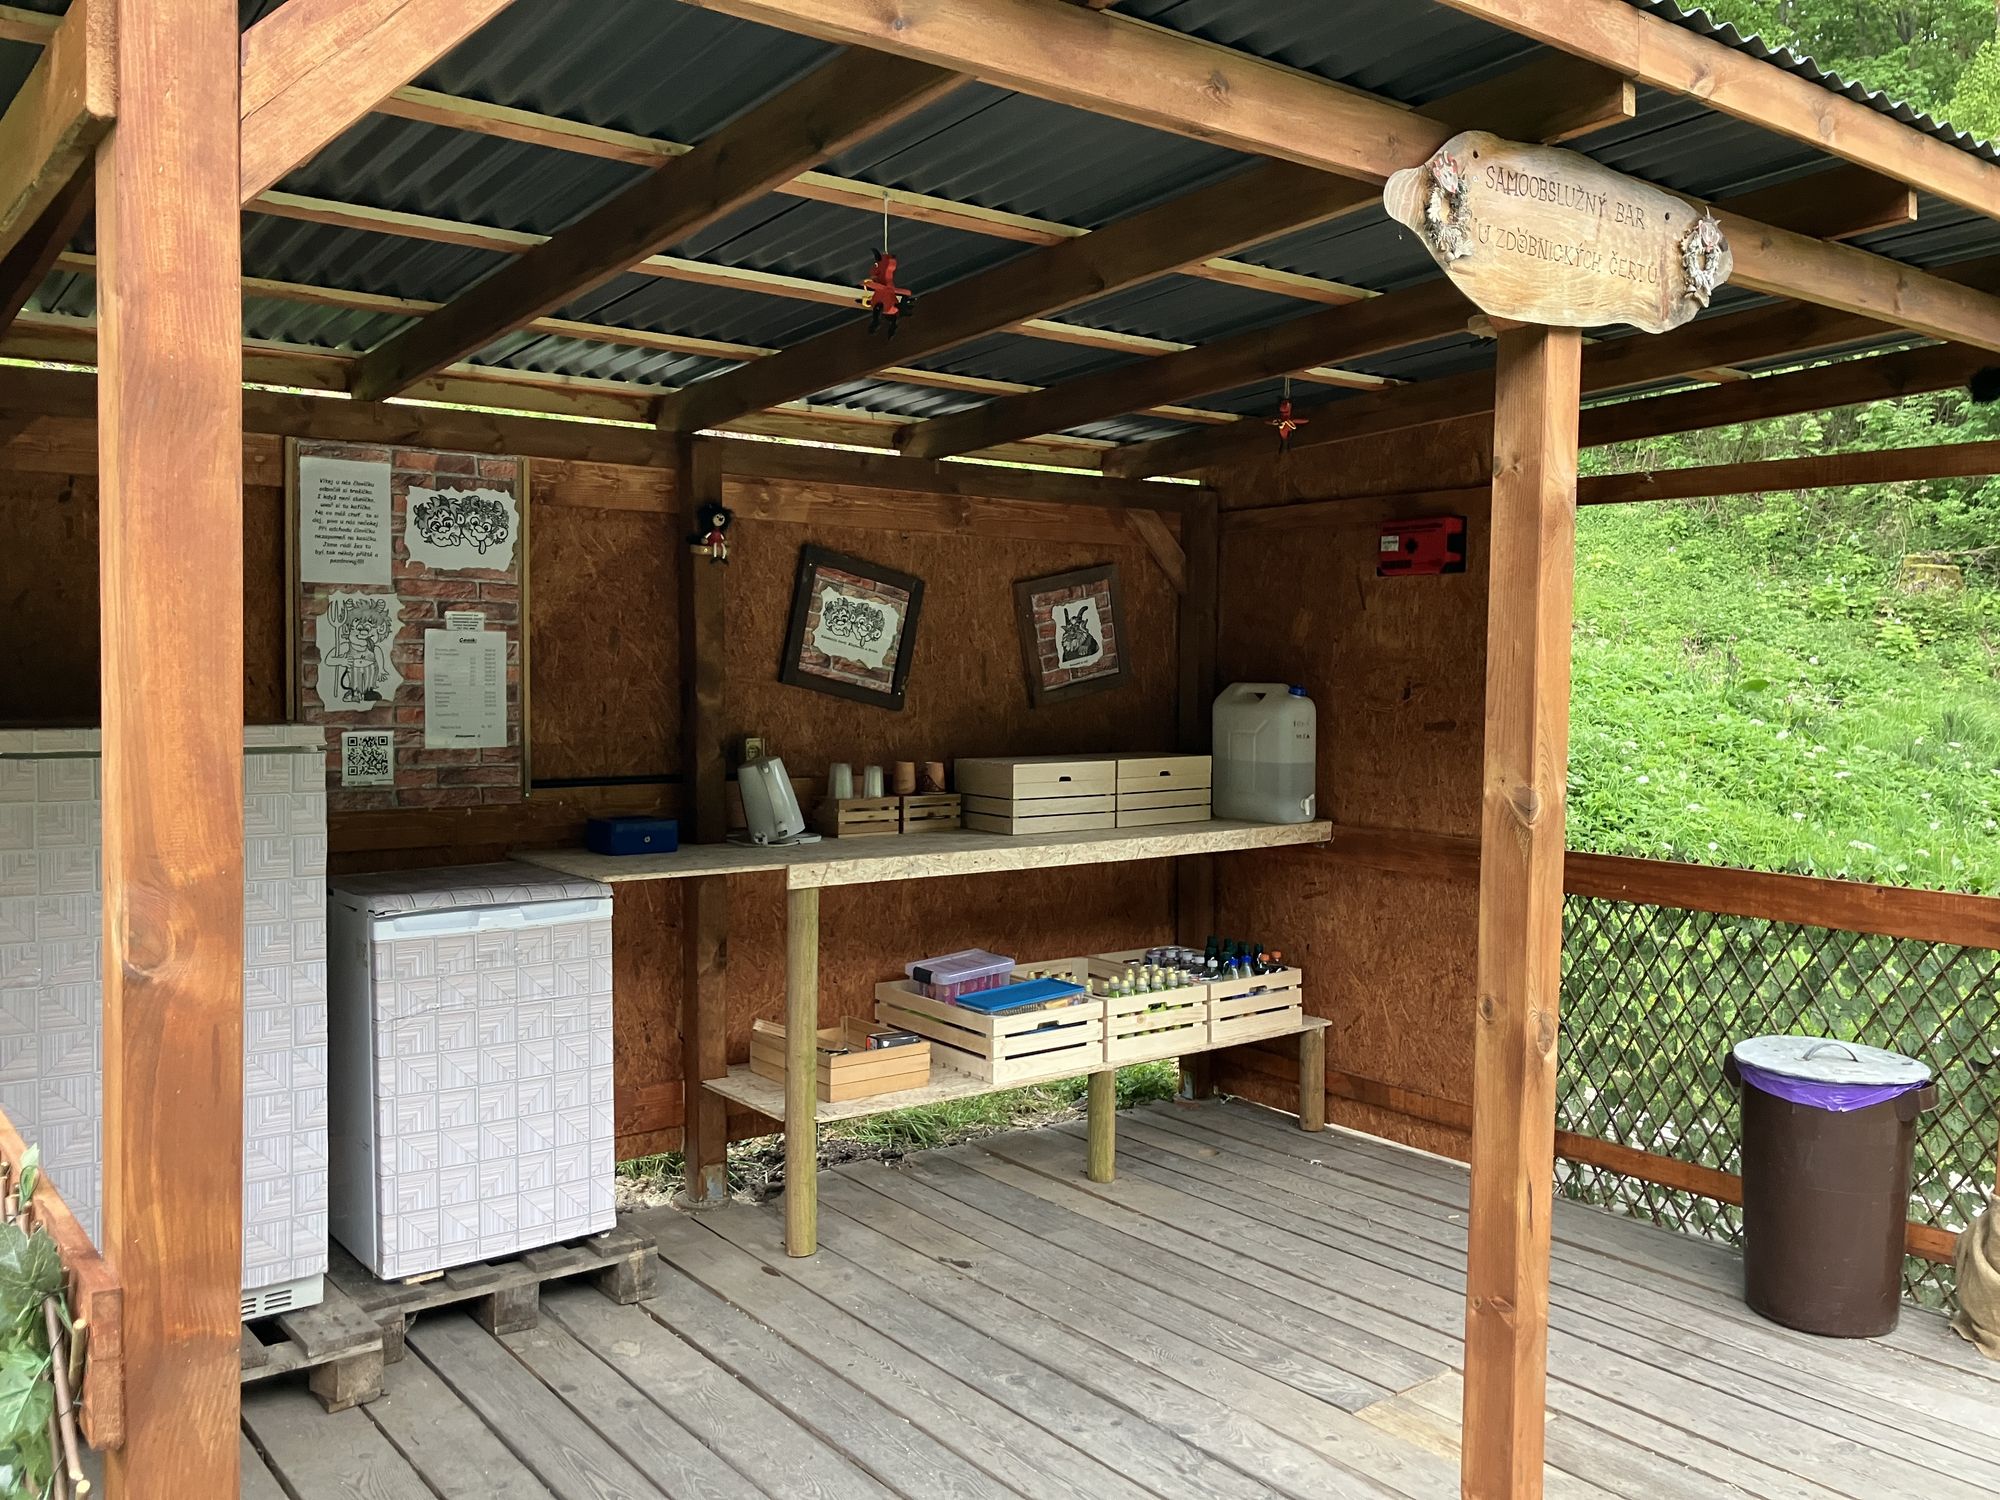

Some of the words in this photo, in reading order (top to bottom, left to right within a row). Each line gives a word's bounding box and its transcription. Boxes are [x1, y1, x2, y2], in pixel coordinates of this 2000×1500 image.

[1485, 165, 1608, 216] SAMOOBSLUŽNÝ
[1614, 202, 1647, 230] BAR
[1477, 224, 1492, 244] U
